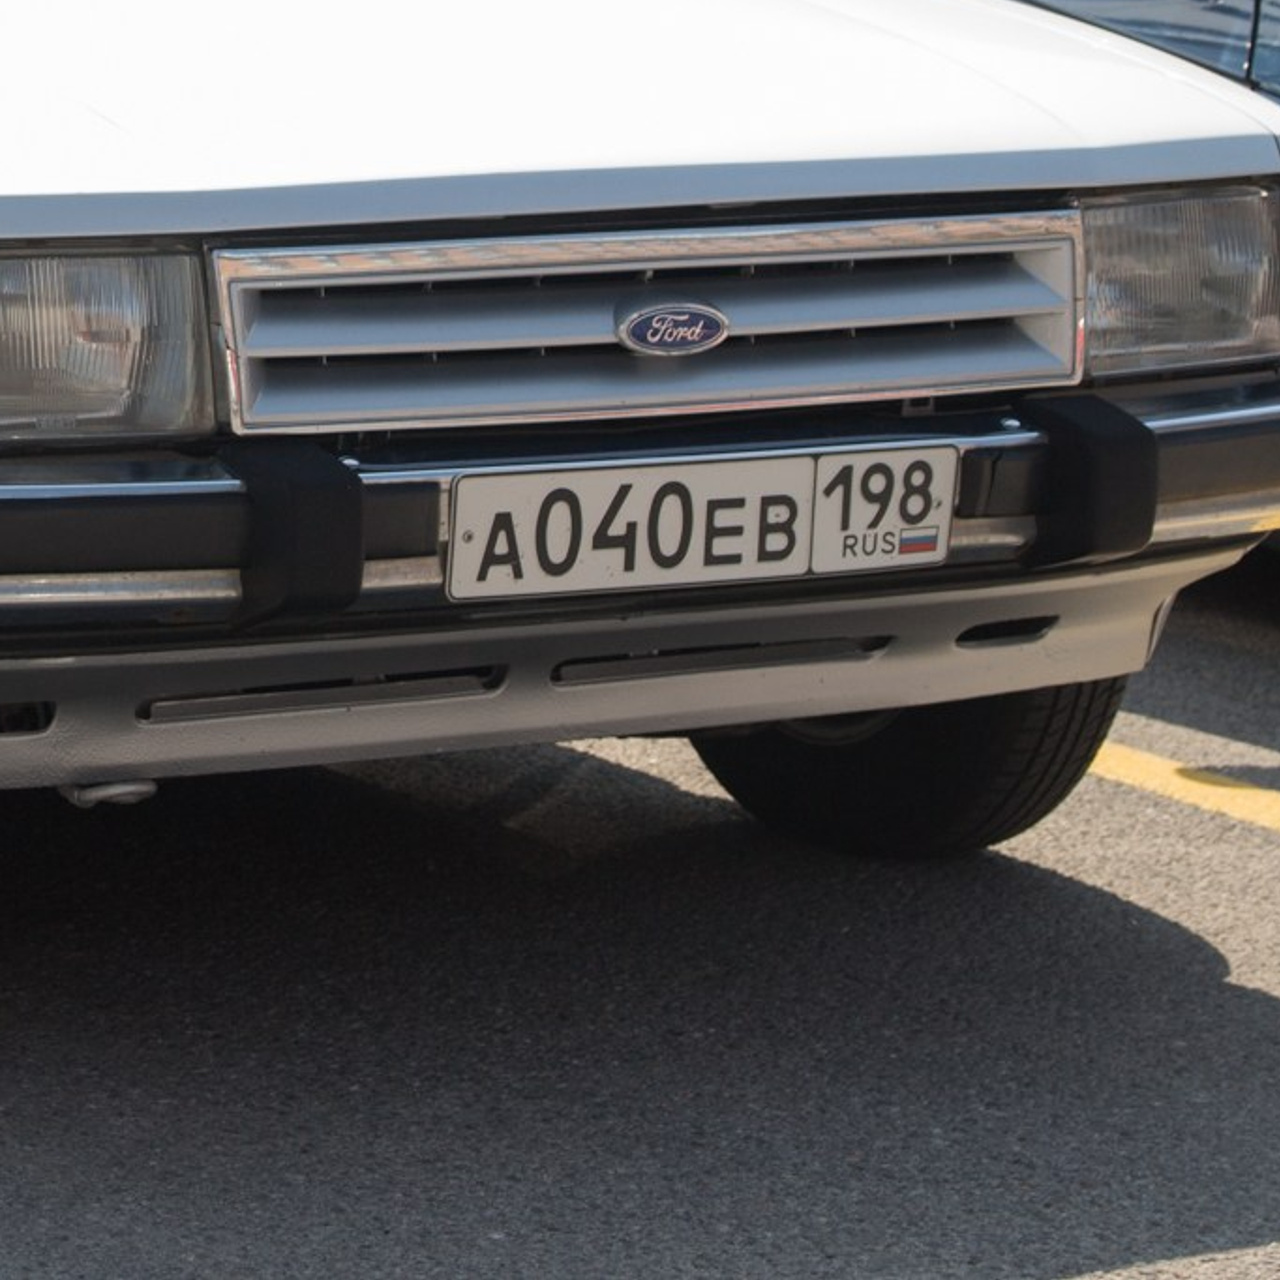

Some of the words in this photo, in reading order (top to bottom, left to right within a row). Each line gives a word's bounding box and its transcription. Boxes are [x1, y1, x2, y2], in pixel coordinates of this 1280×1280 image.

[646, 313, 705, 343] Ford
[822, 460, 934, 532] 198
[842, 531, 897, 558] RUS
